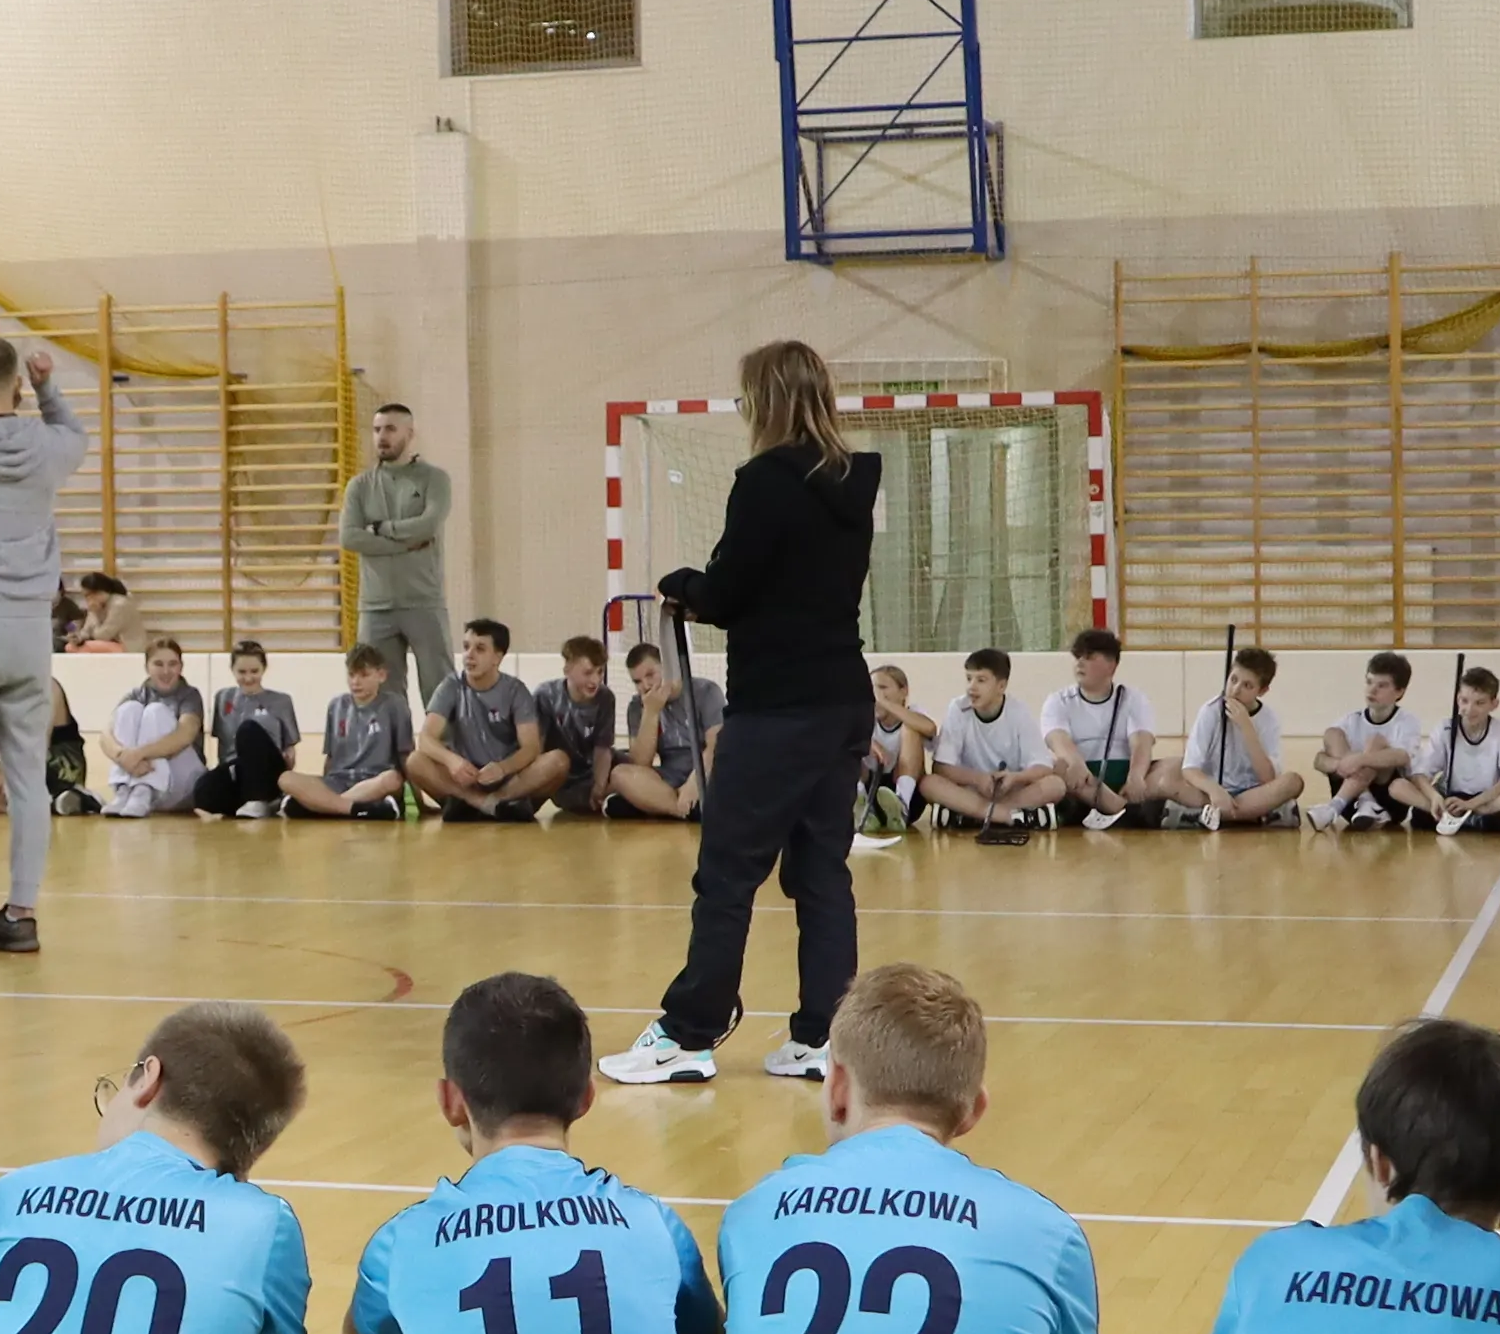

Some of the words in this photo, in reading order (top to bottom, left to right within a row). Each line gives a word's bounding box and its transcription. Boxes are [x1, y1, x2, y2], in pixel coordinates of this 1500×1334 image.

[17, 1187, 204, 1232] KAROLKOWA
[436, 1196, 629, 1247] KAROLKOWA
[775, 1187, 977, 1229] KAROLKOWA
